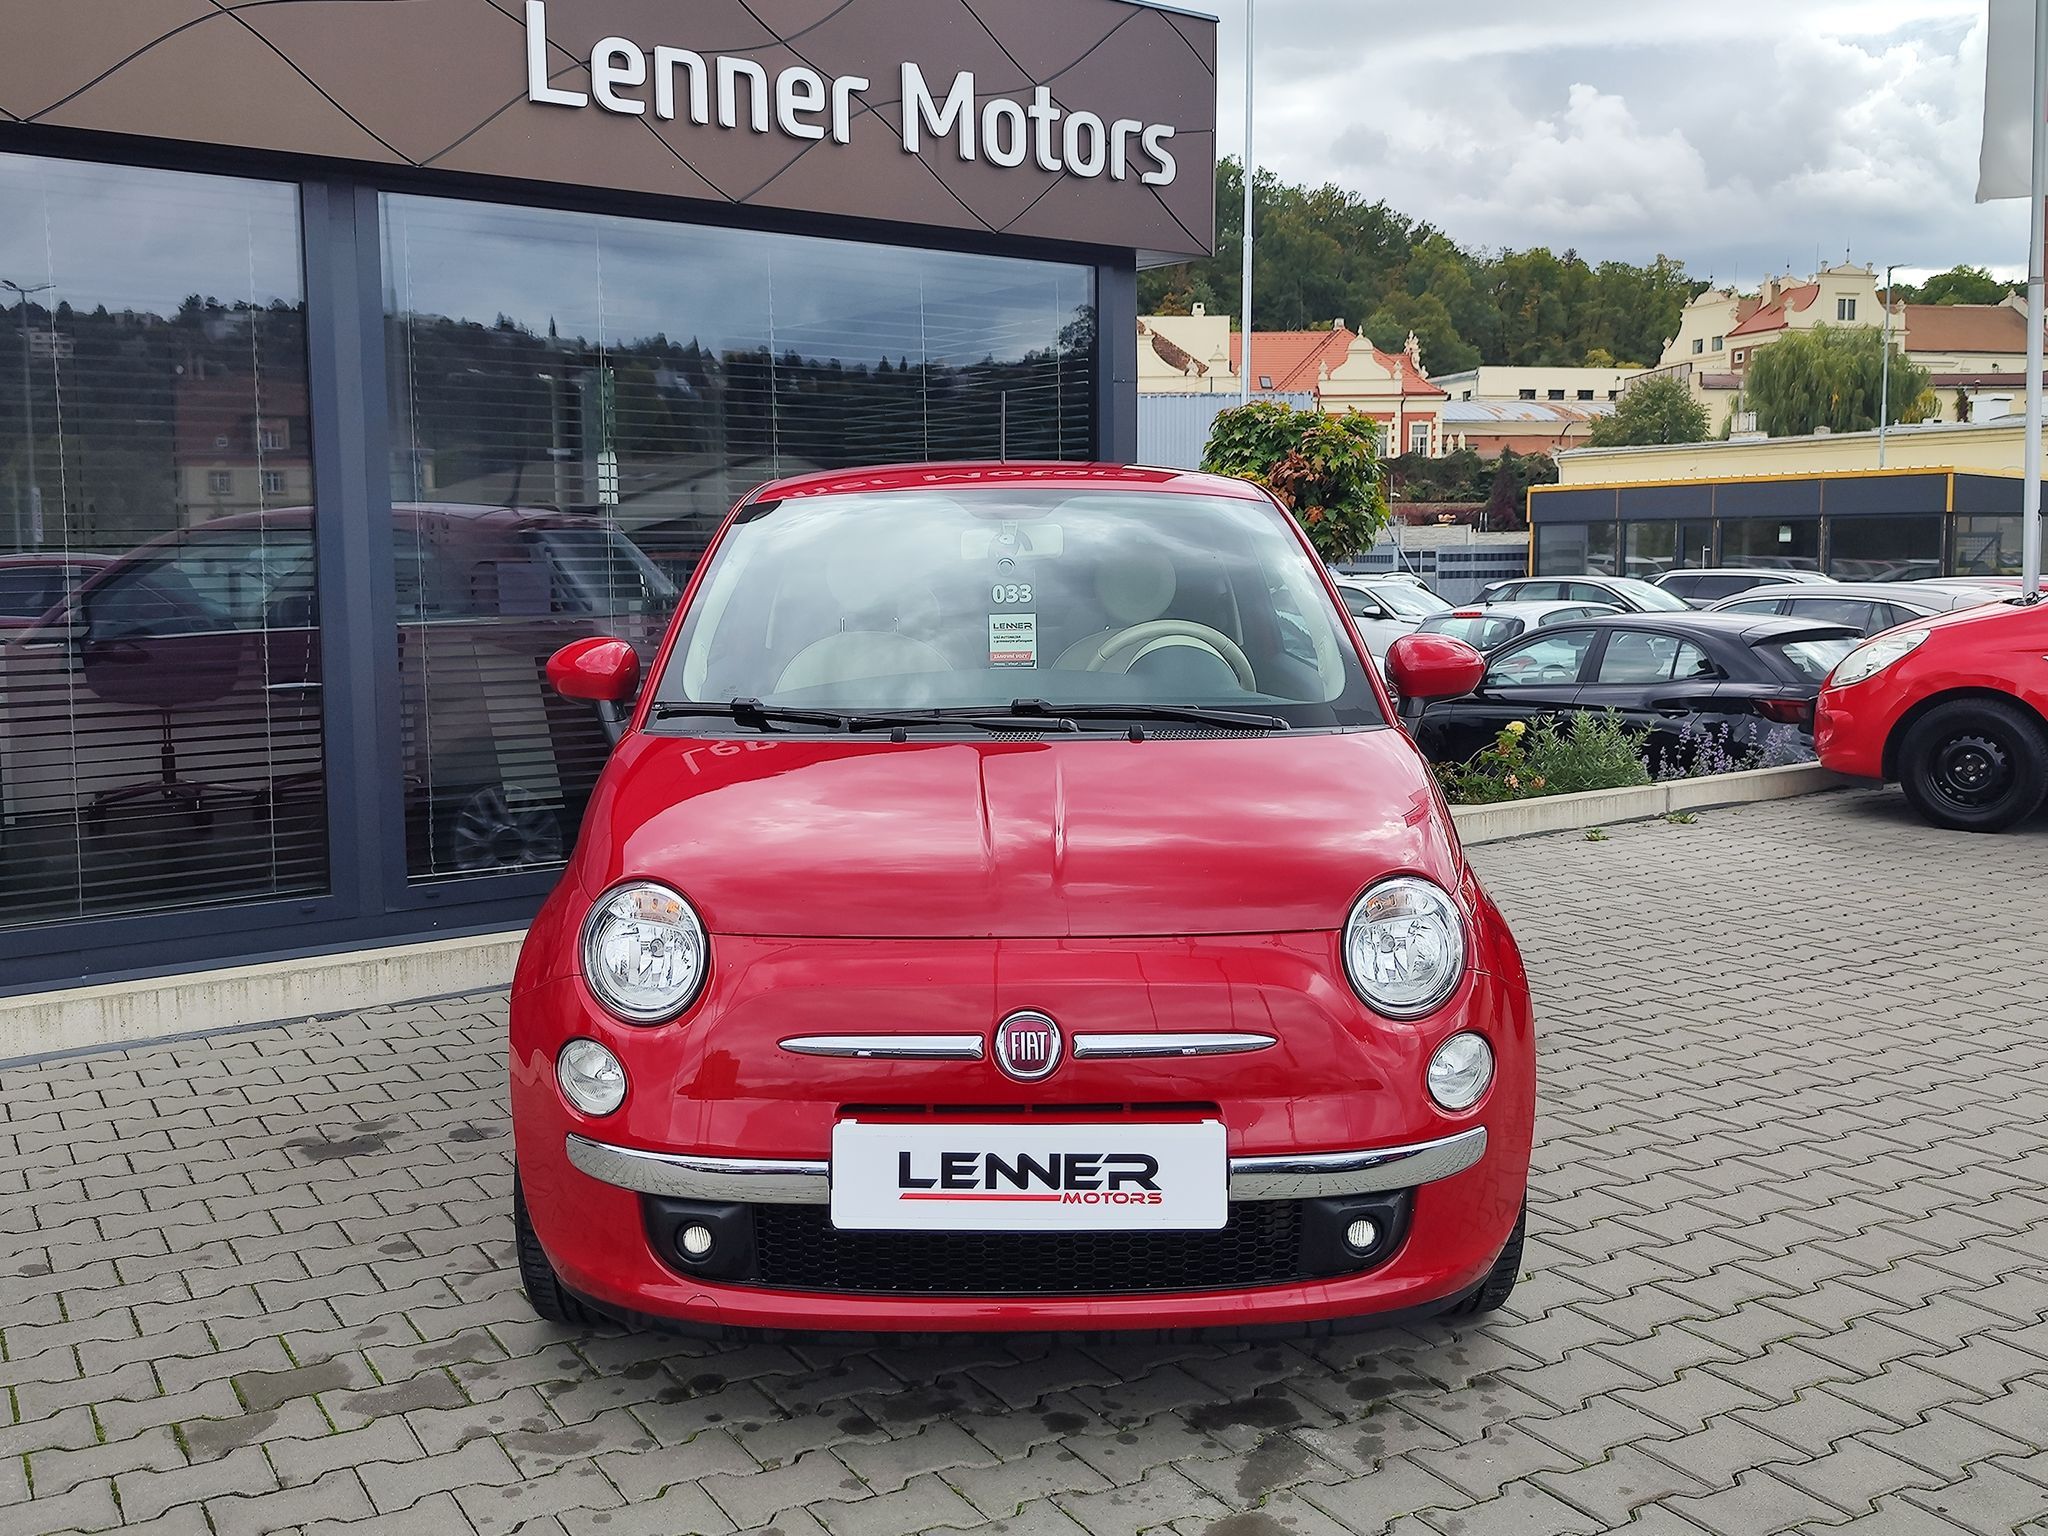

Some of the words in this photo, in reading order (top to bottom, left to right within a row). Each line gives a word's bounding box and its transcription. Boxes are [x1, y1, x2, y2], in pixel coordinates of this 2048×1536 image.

[526, 0, 870, 146] Lenner
[900, 61, 1176, 186] Motors
[991, 583, 1033, 604] 033
[993, 622, 1033, 630] LENNER
[1010, 1031, 1048, 1061] FIAT
[898, 1150, 1163, 1191] LENNER
[1061, 1192, 1163, 1204] MOTORS
